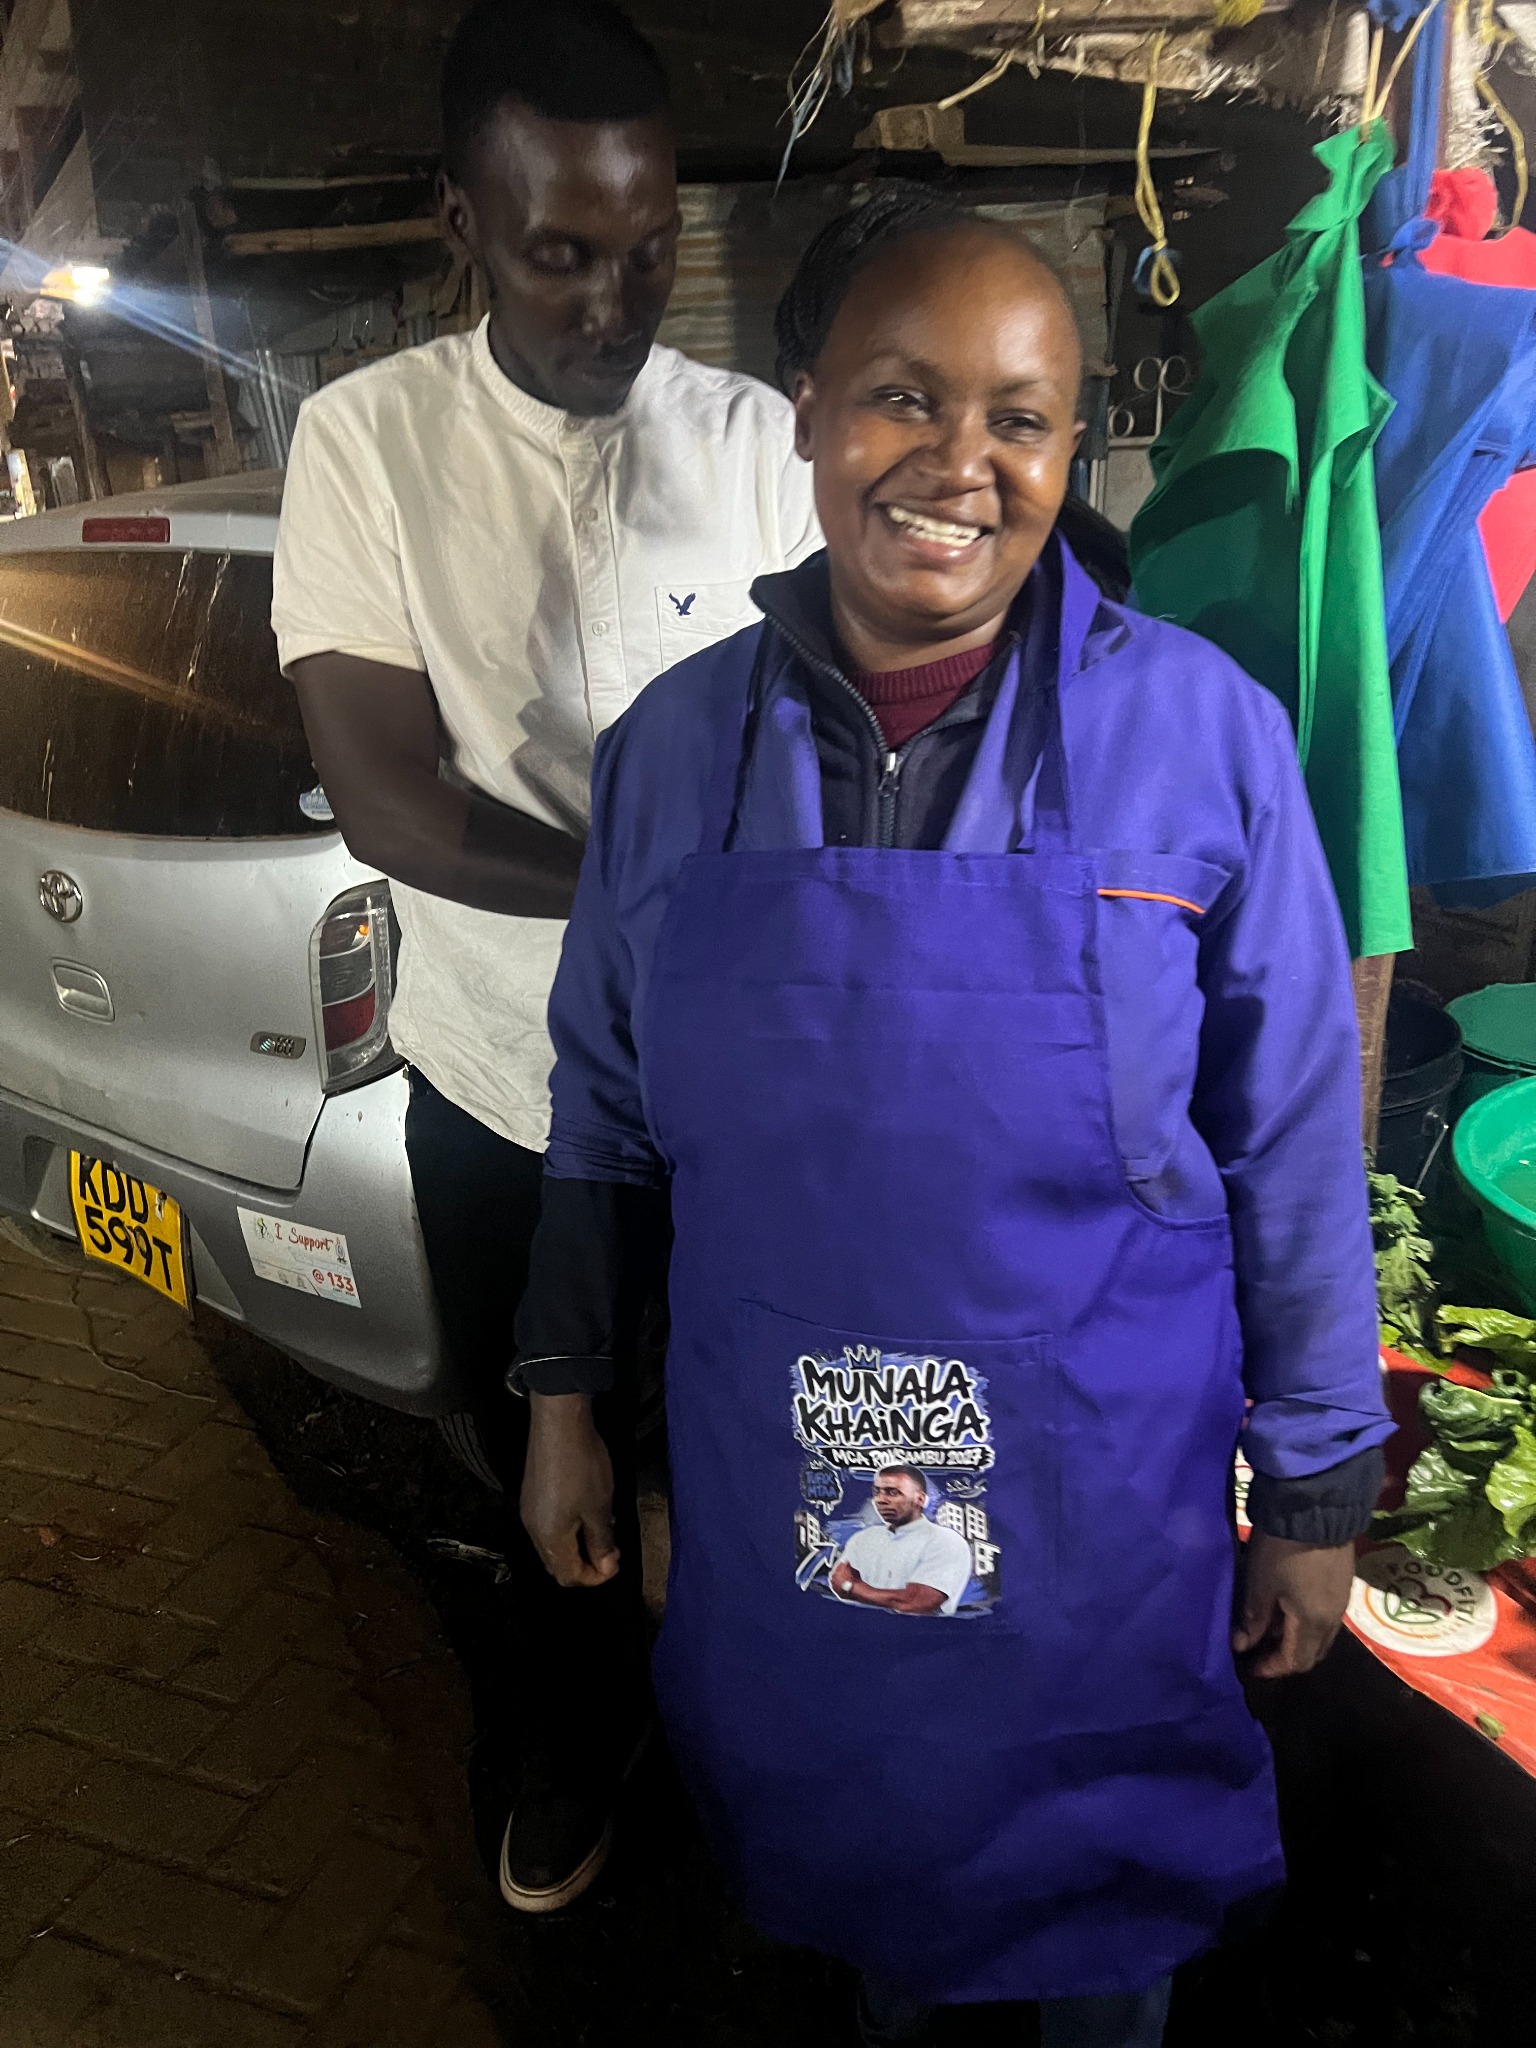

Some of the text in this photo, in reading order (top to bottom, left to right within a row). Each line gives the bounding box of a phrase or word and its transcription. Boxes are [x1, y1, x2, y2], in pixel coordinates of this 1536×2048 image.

[79, 1152, 149, 1224] KDD
[85, 1204, 173, 1292] 599T
[274, 1222, 334, 1252] I Support
[801, 1358, 975, 1406] MUNALA
[831, 1448, 870, 1467] MCA
